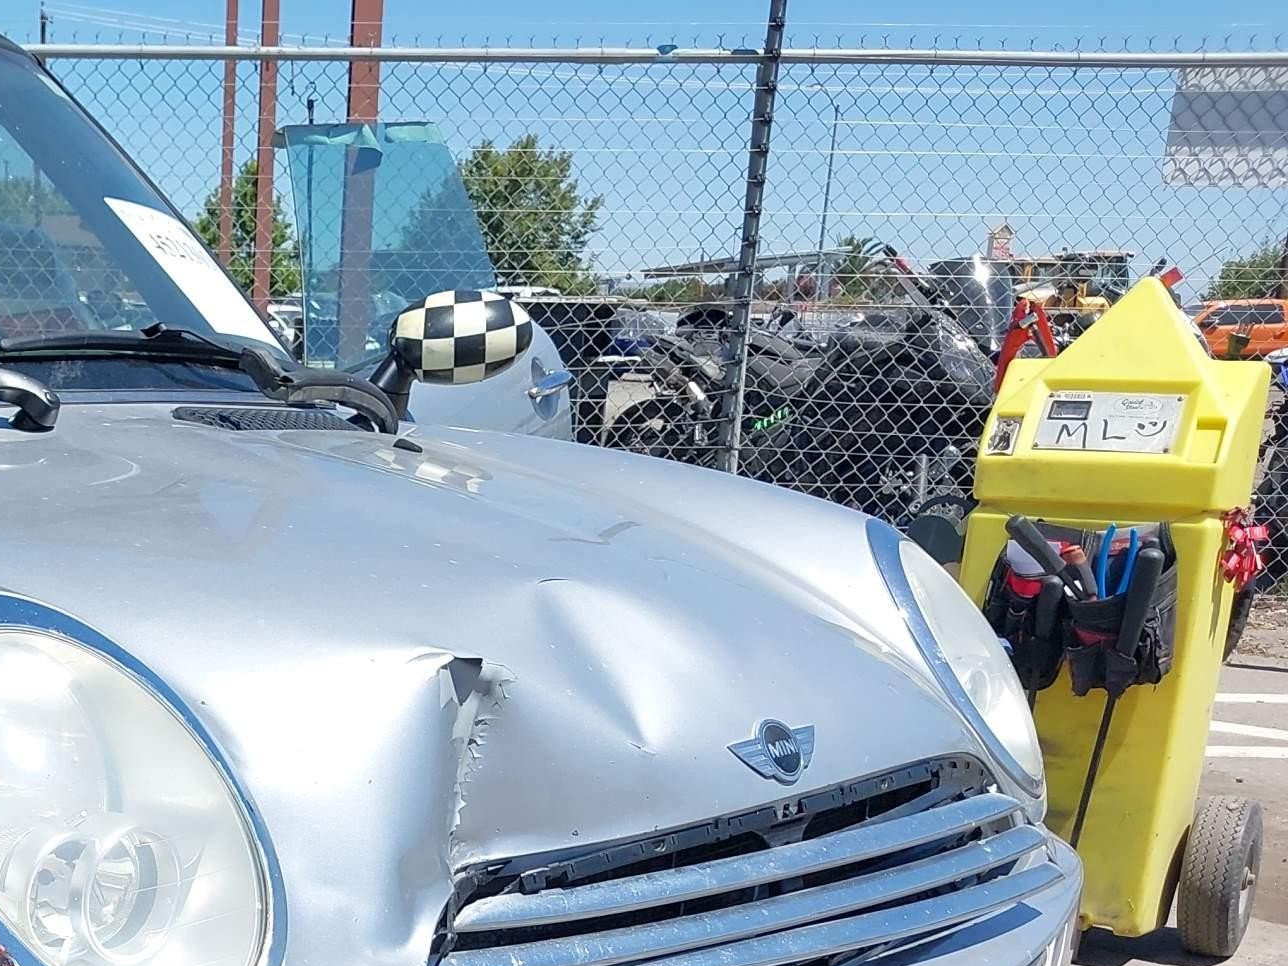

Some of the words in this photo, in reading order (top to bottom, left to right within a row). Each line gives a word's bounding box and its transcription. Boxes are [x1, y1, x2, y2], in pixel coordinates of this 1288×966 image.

[1056, 422, 1088, 449] M
[1102, 419, 1126, 440] L
[768, 738, 799, 758] MINI
